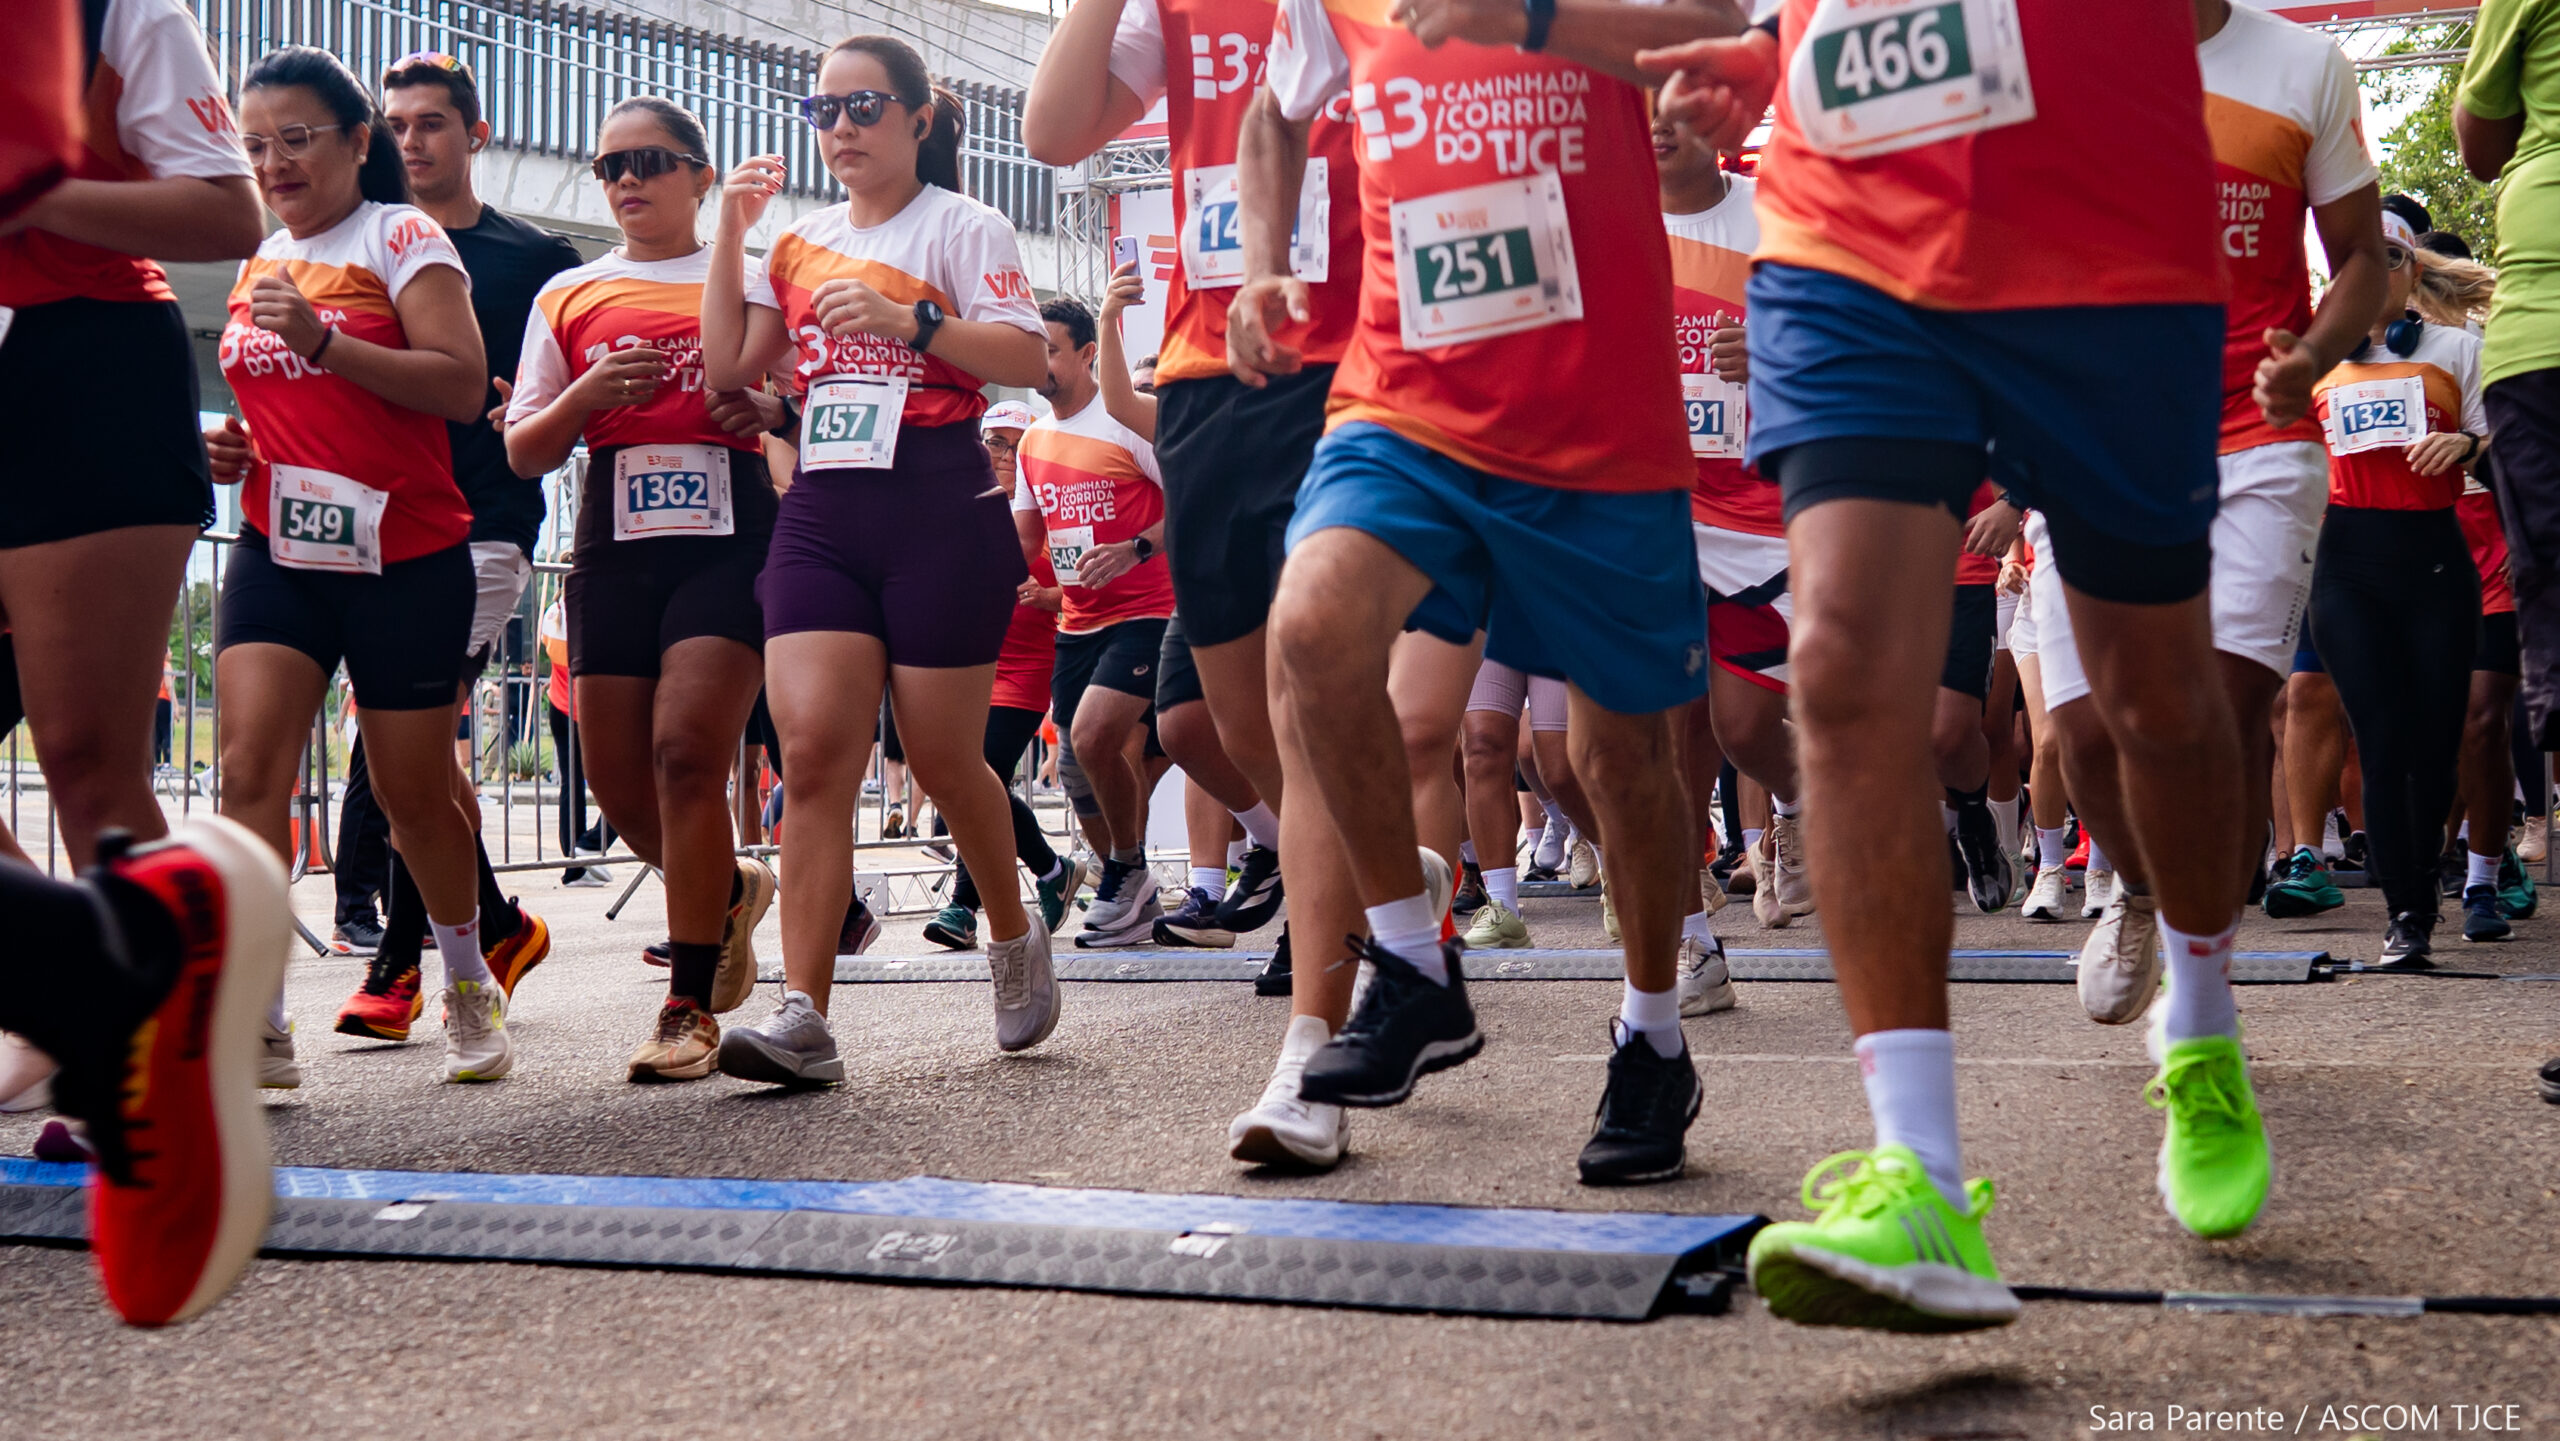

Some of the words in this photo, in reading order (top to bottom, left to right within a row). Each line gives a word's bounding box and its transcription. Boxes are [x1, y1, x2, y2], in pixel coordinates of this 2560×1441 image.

[1834, 8, 1949, 97] 466
[1442, 70, 1591, 103] CAMINHADA
[1435, 131, 1482, 164] DO
[1486, 127, 1586, 174] TJCE
[2222, 223, 2260, 257] CE
[1428, 232, 1514, 299] 251
[243, 353, 275, 377] DO
[815, 405, 868, 440] 457
[1685, 401, 1720, 433] 91
[2344, 401, 2406, 432] 1323
[630, 473, 707, 509] 1362
[1061, 479, 1116, 494] CAMINHADA
[288, 500, 344, 541] 549
[1061, 505, 1076, 521] DO
[1075, 501, 1117, 525] TJCE
[1051, 547, 1078, 568] 548
